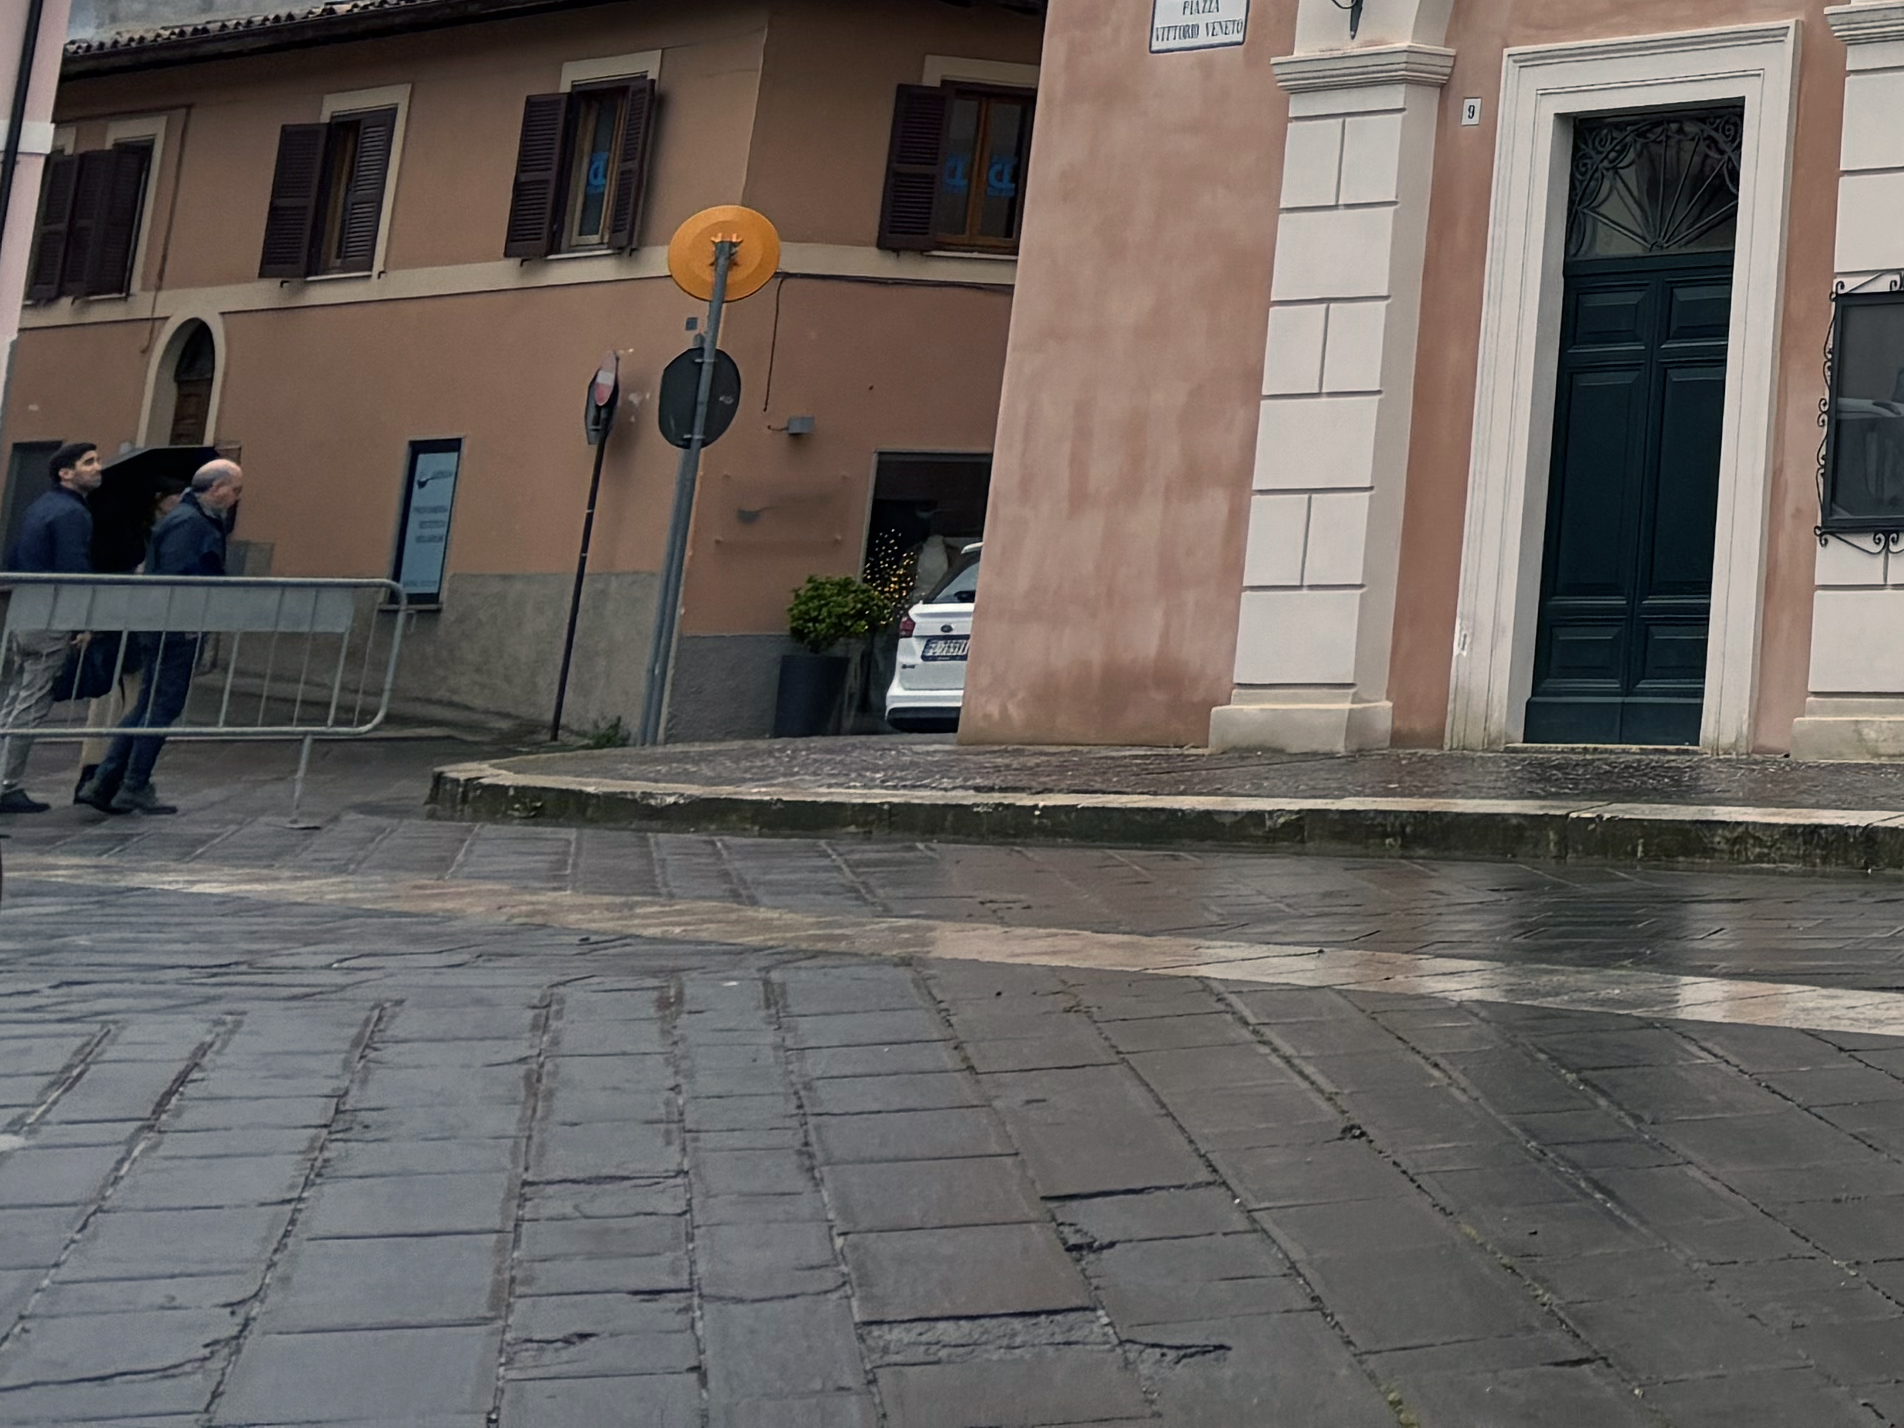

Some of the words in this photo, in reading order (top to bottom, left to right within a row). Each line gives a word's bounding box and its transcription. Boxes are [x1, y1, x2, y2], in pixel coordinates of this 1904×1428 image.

[1156, 23, 1200, 42] VITTORIO
[1206, 19, 1243, 37] VENETO
[1467, 104, 1476, 120] 9
